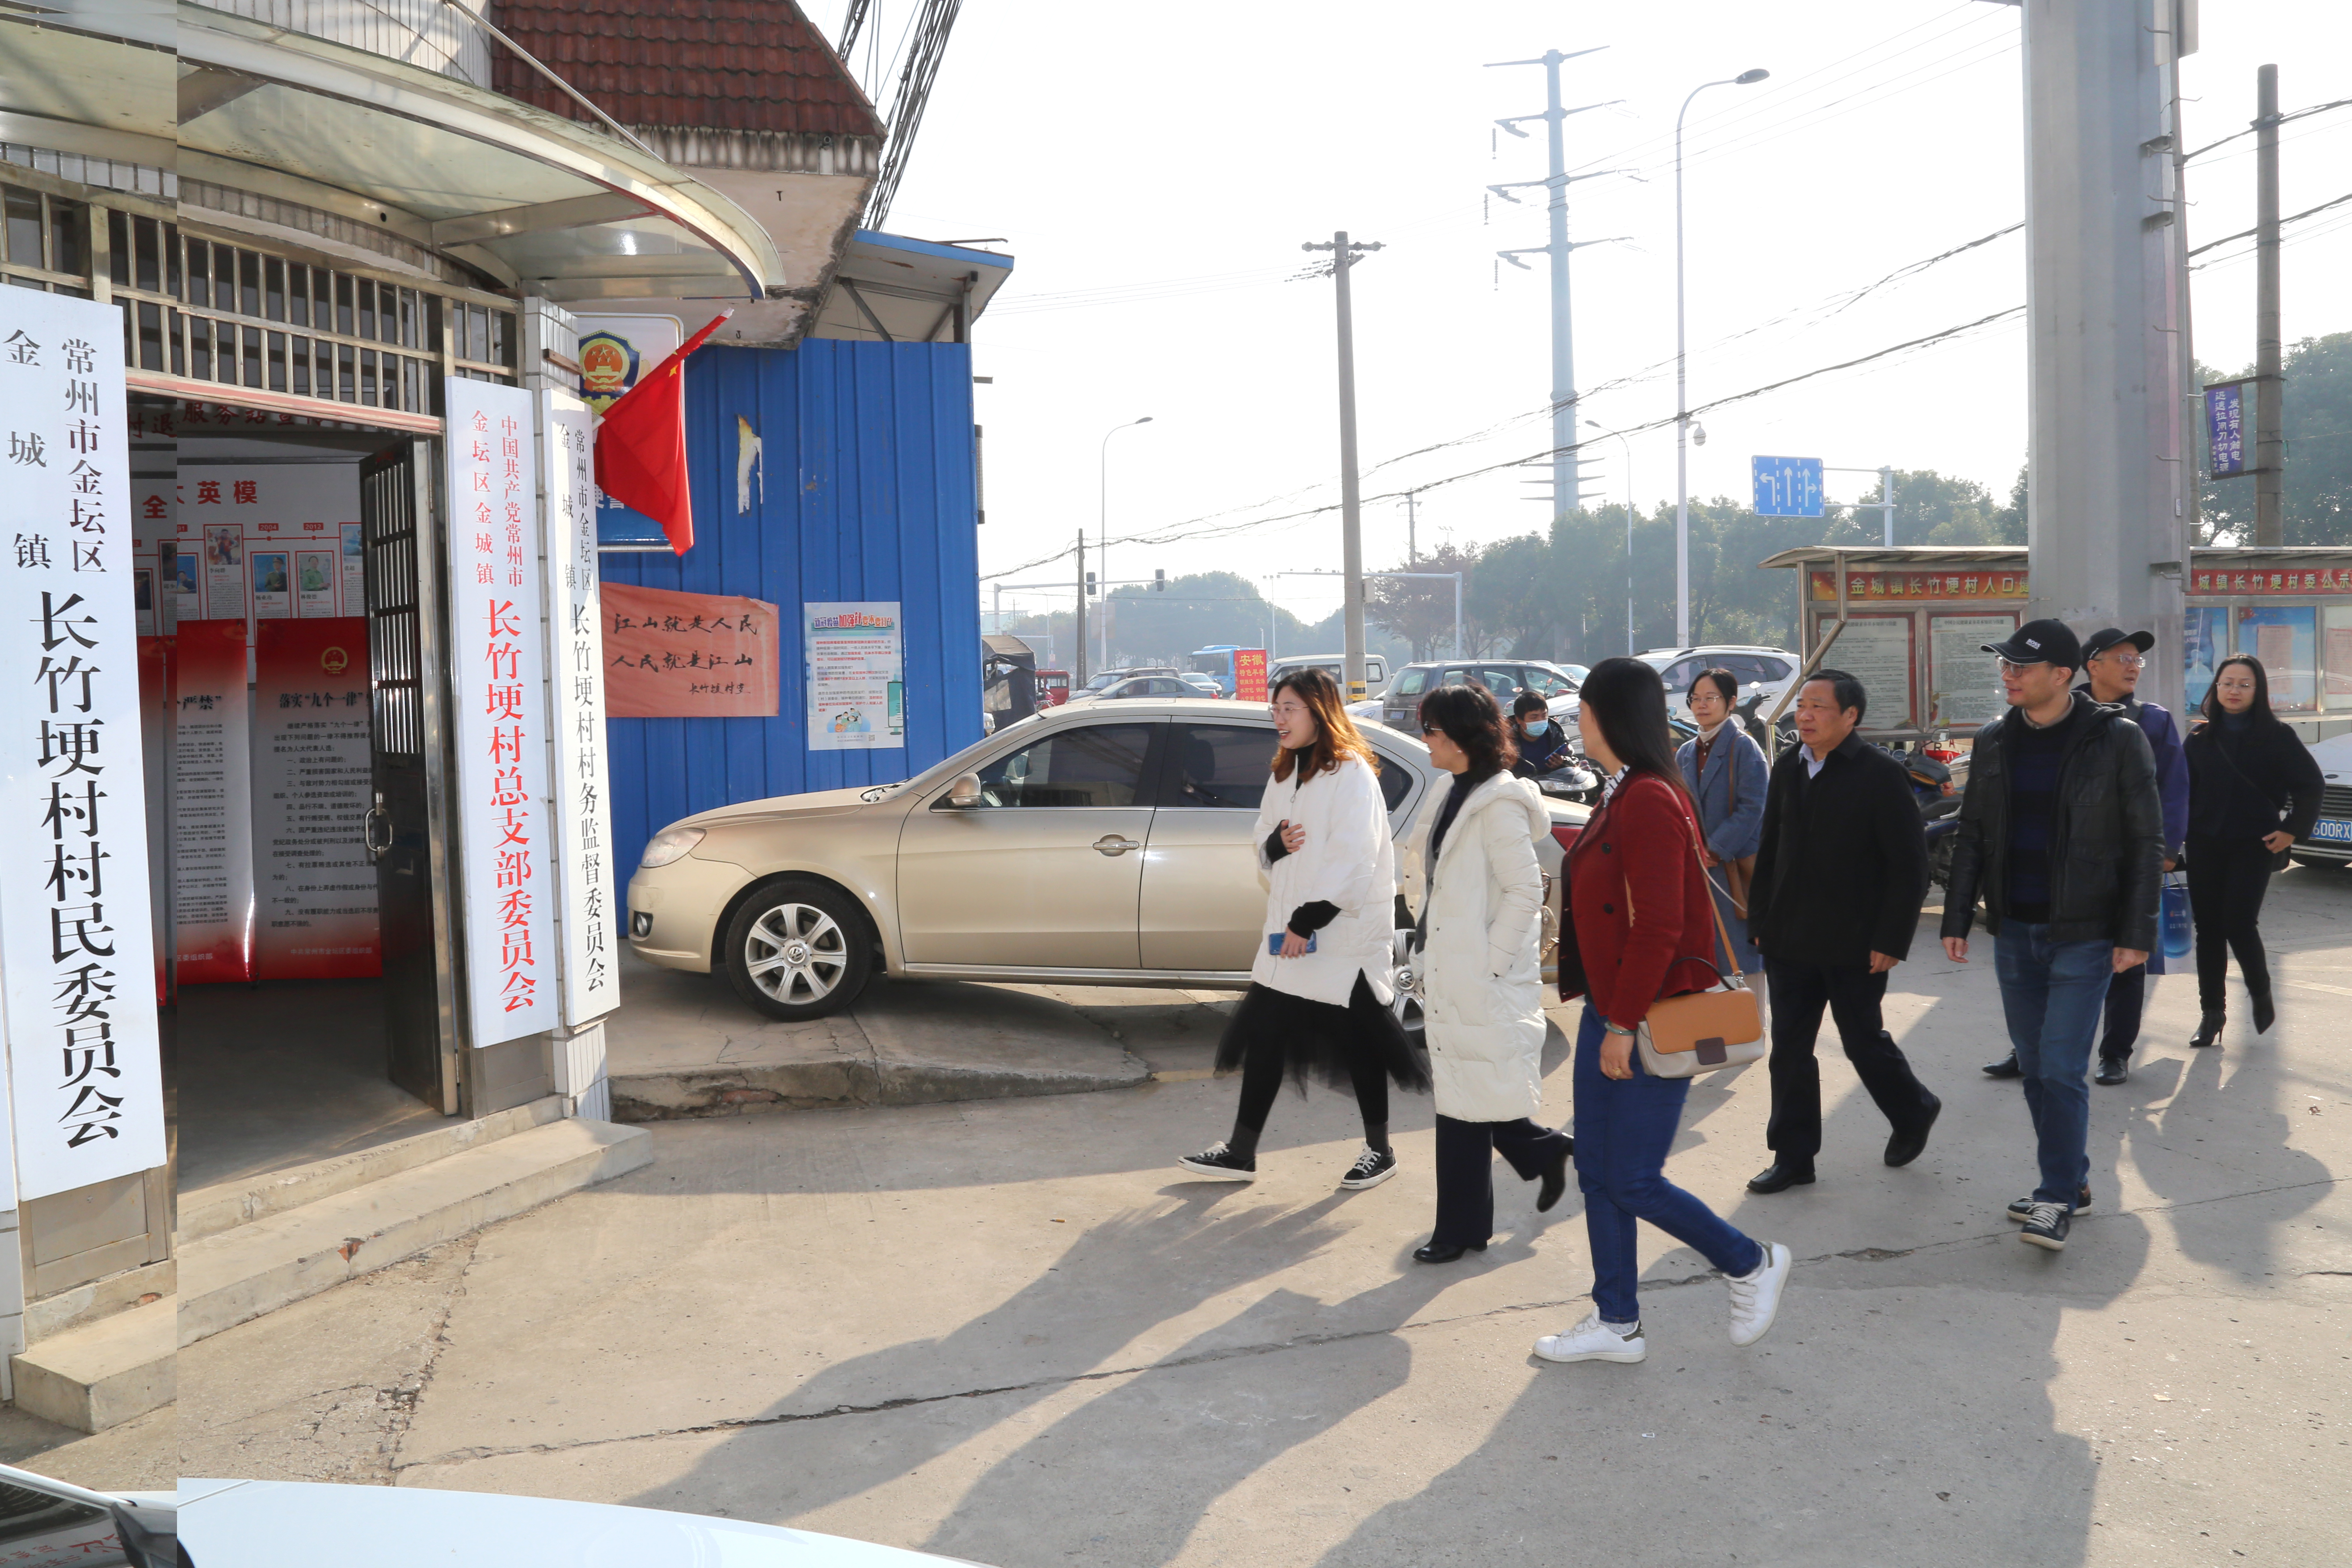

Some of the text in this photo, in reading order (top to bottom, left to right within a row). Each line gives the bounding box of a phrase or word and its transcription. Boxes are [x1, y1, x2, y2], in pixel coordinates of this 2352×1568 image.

[2, 329, 52, 569] 金城镇
[61, 337, 108, 574] 常州市金坛区
[142, 495, 168, 519] 全
[471, 410, 494, 585] 金坛区金城镇
[501, 415, 523, 587] 中国共产党常州市
[559, 423, 577, 590] 金城镇
[574, 429, 592, 591] 常州市金坛区
[611, 650, 753, 673] 人民就是江山
[614, 613, 757, 635] 江山就是人民
[1239, 653, 1264, 666] 安徽
[2199, 574, 2352, 590] 城镇长竹埂村委公示
[177, 695, 222, 710] 严禁”
[29, 590, 125, 1149] 长竹埂村村民委员会
[482, 599, 536, 1013] 长竹埂村总支部委员会
[571, 603, 606, 993] 长竹埂村村务监督委员会
